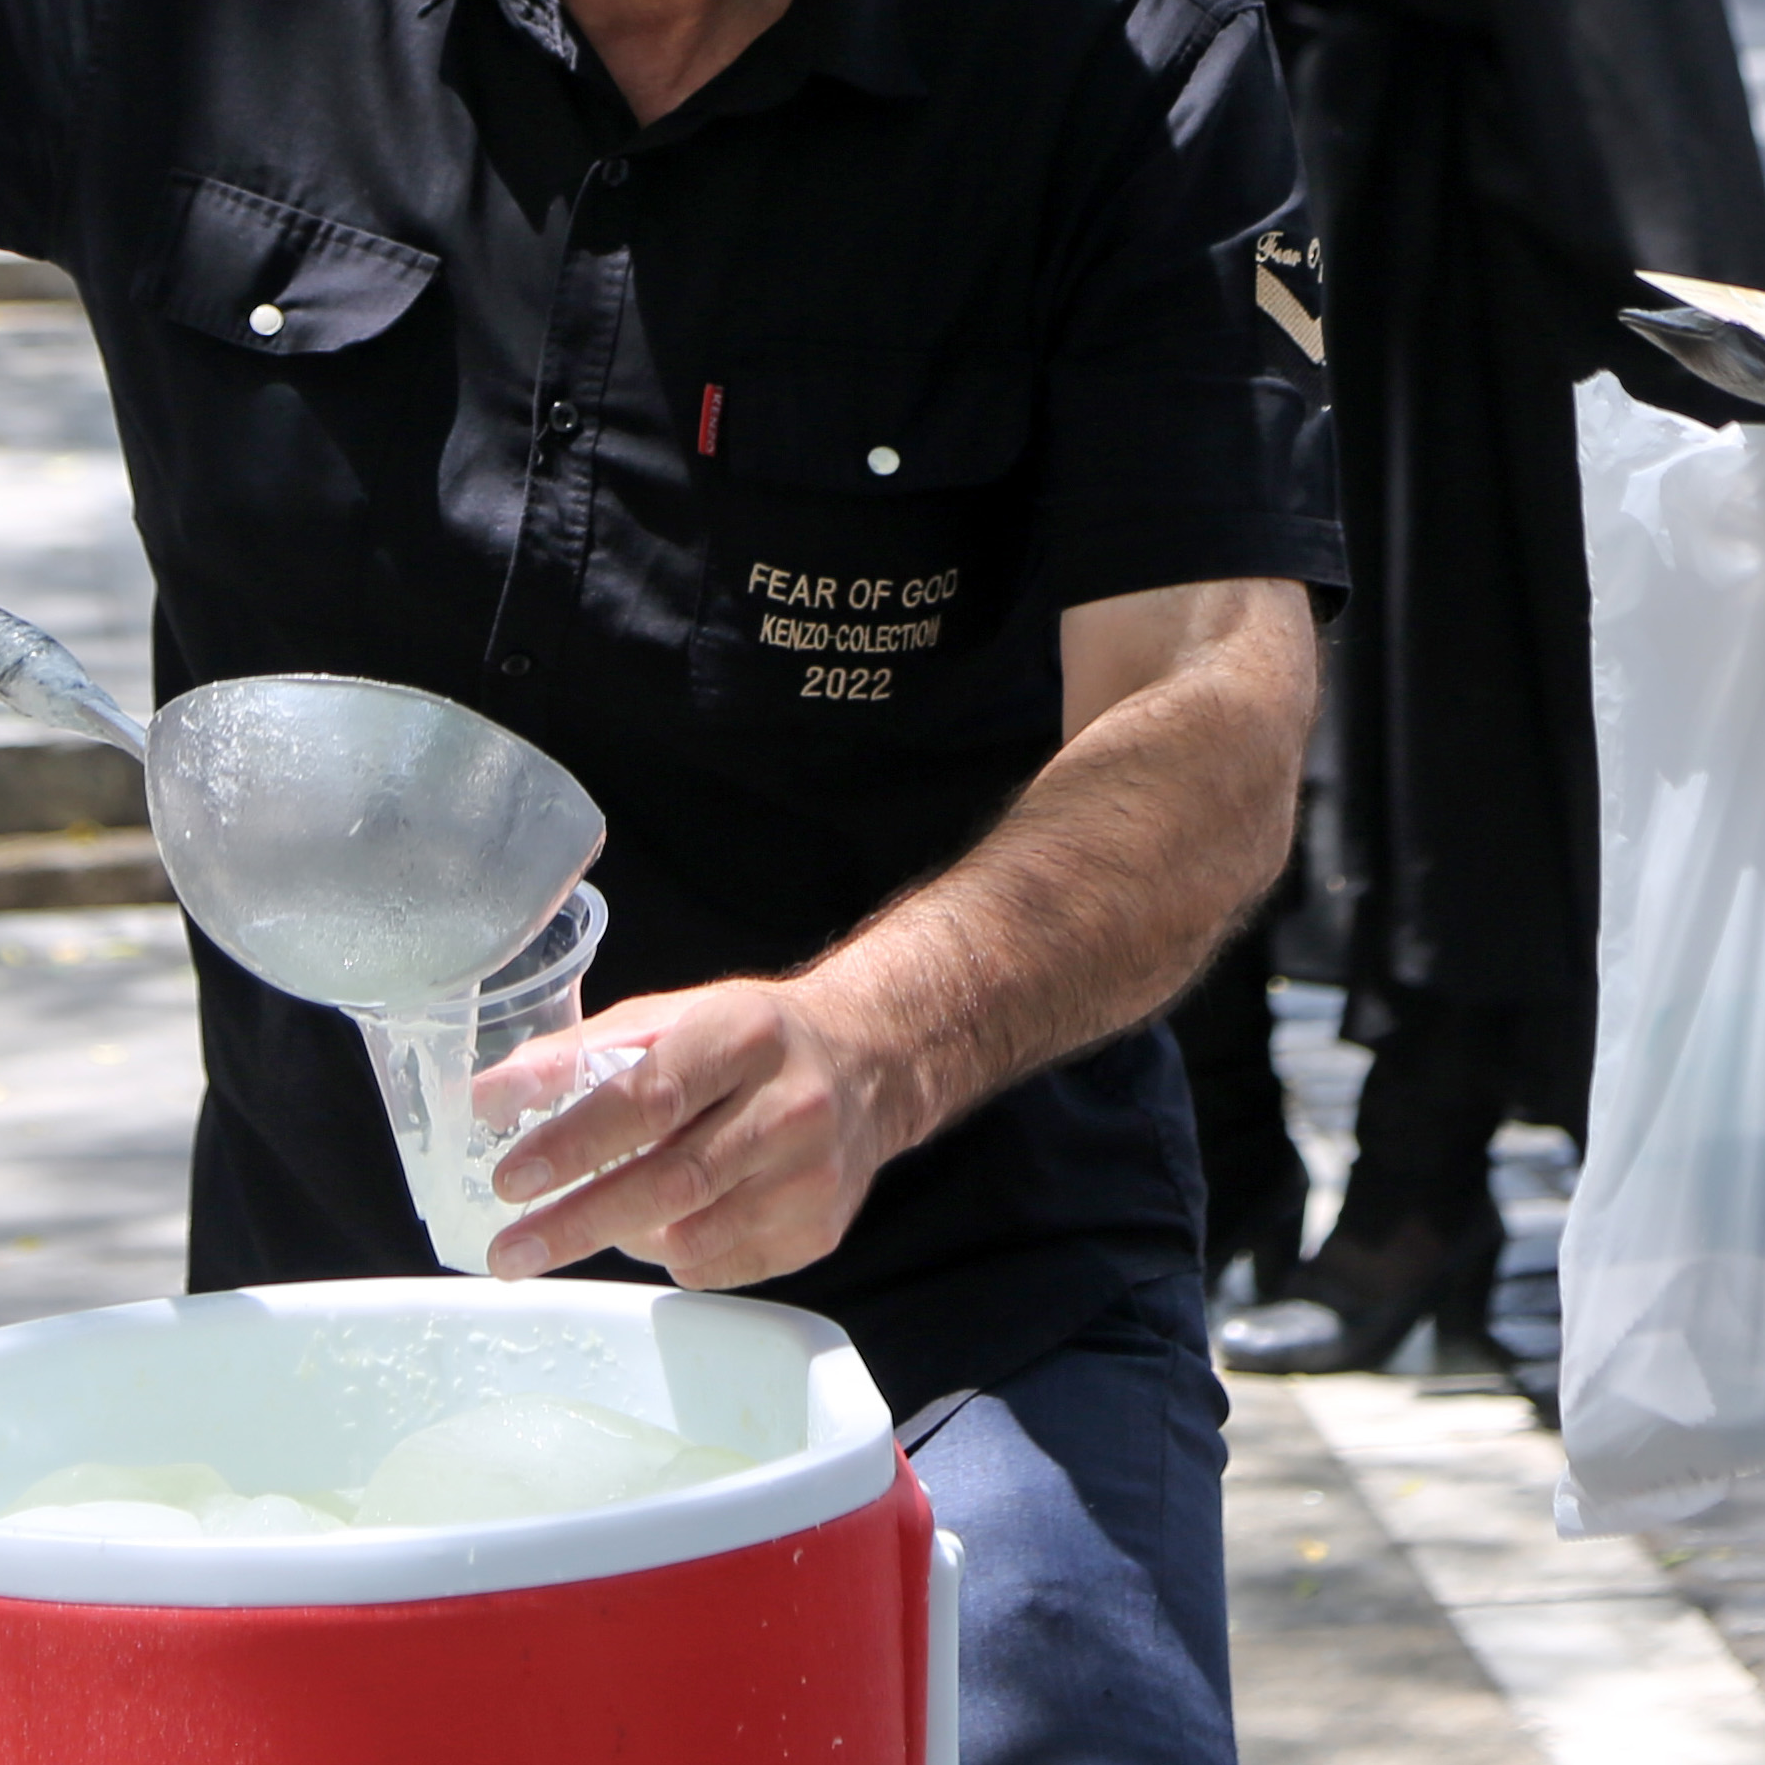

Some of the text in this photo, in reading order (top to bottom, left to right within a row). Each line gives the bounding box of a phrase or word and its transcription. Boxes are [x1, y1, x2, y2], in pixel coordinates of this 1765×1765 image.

[747, 562, 959, 611] FEAR OF GOD
[799, 665, 893, 702] 2022
